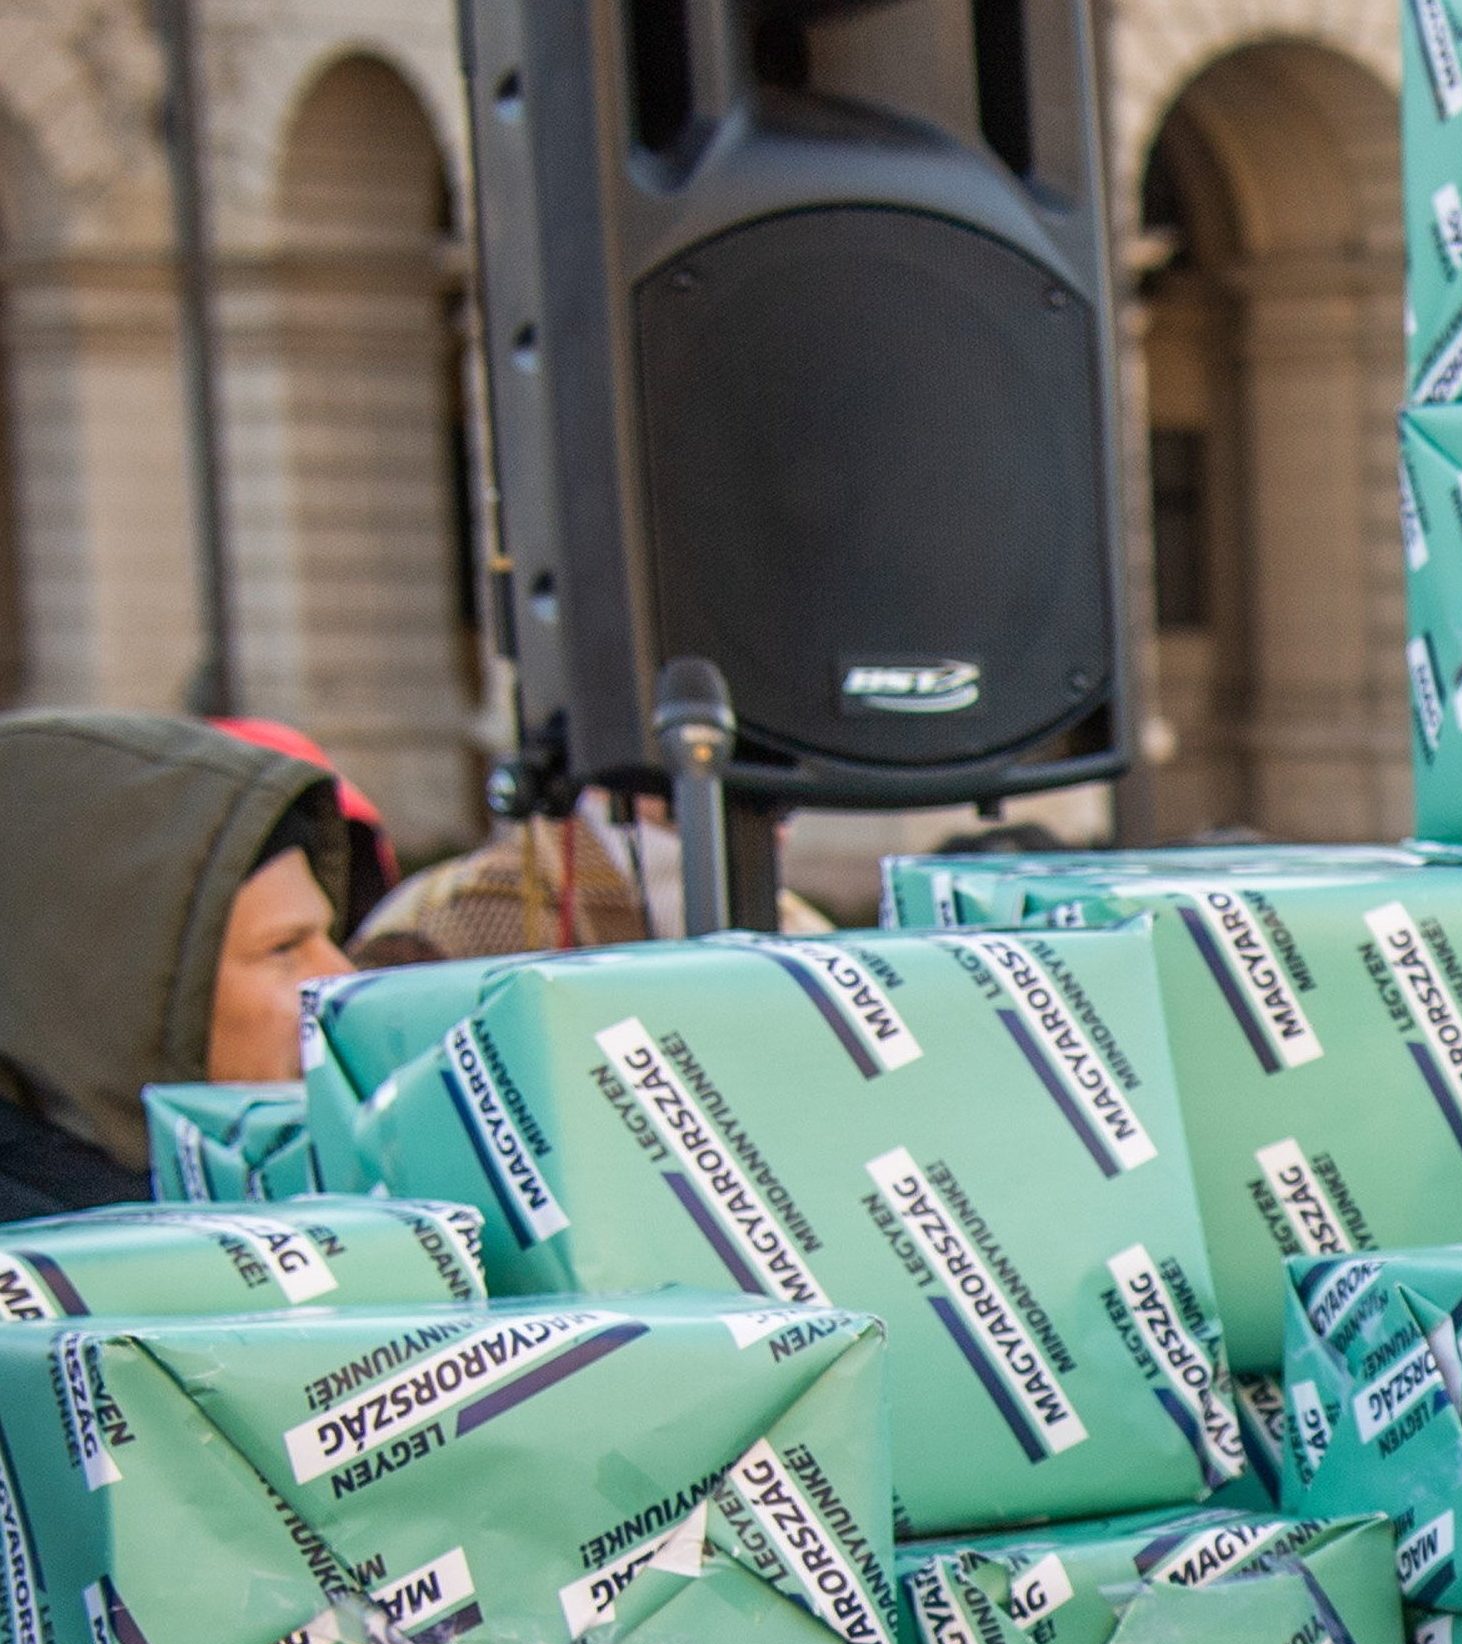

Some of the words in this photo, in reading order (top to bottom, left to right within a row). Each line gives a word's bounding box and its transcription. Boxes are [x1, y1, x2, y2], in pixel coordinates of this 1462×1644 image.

[1358, 941, 1413, 1033] LEGYEN
[590, 1062, 668, 1163] LEGYEN
[659, 1030, 823, 1255] MINDANNYIUNKÉ!
[624, 1045, 817, 1304] MAGYARORSZÁG
[861, 1194, 934, 1288] LEGYEN
[925, 1159, 1078, 1373] MINDANNYIUNKÉ!
[894, 1174, 1069, 1426] MAGYARORSZÁG
[1100, 1287, 1159, 1380] LEGYEN
[332, 1422, 446, 1500] LEGYEN
